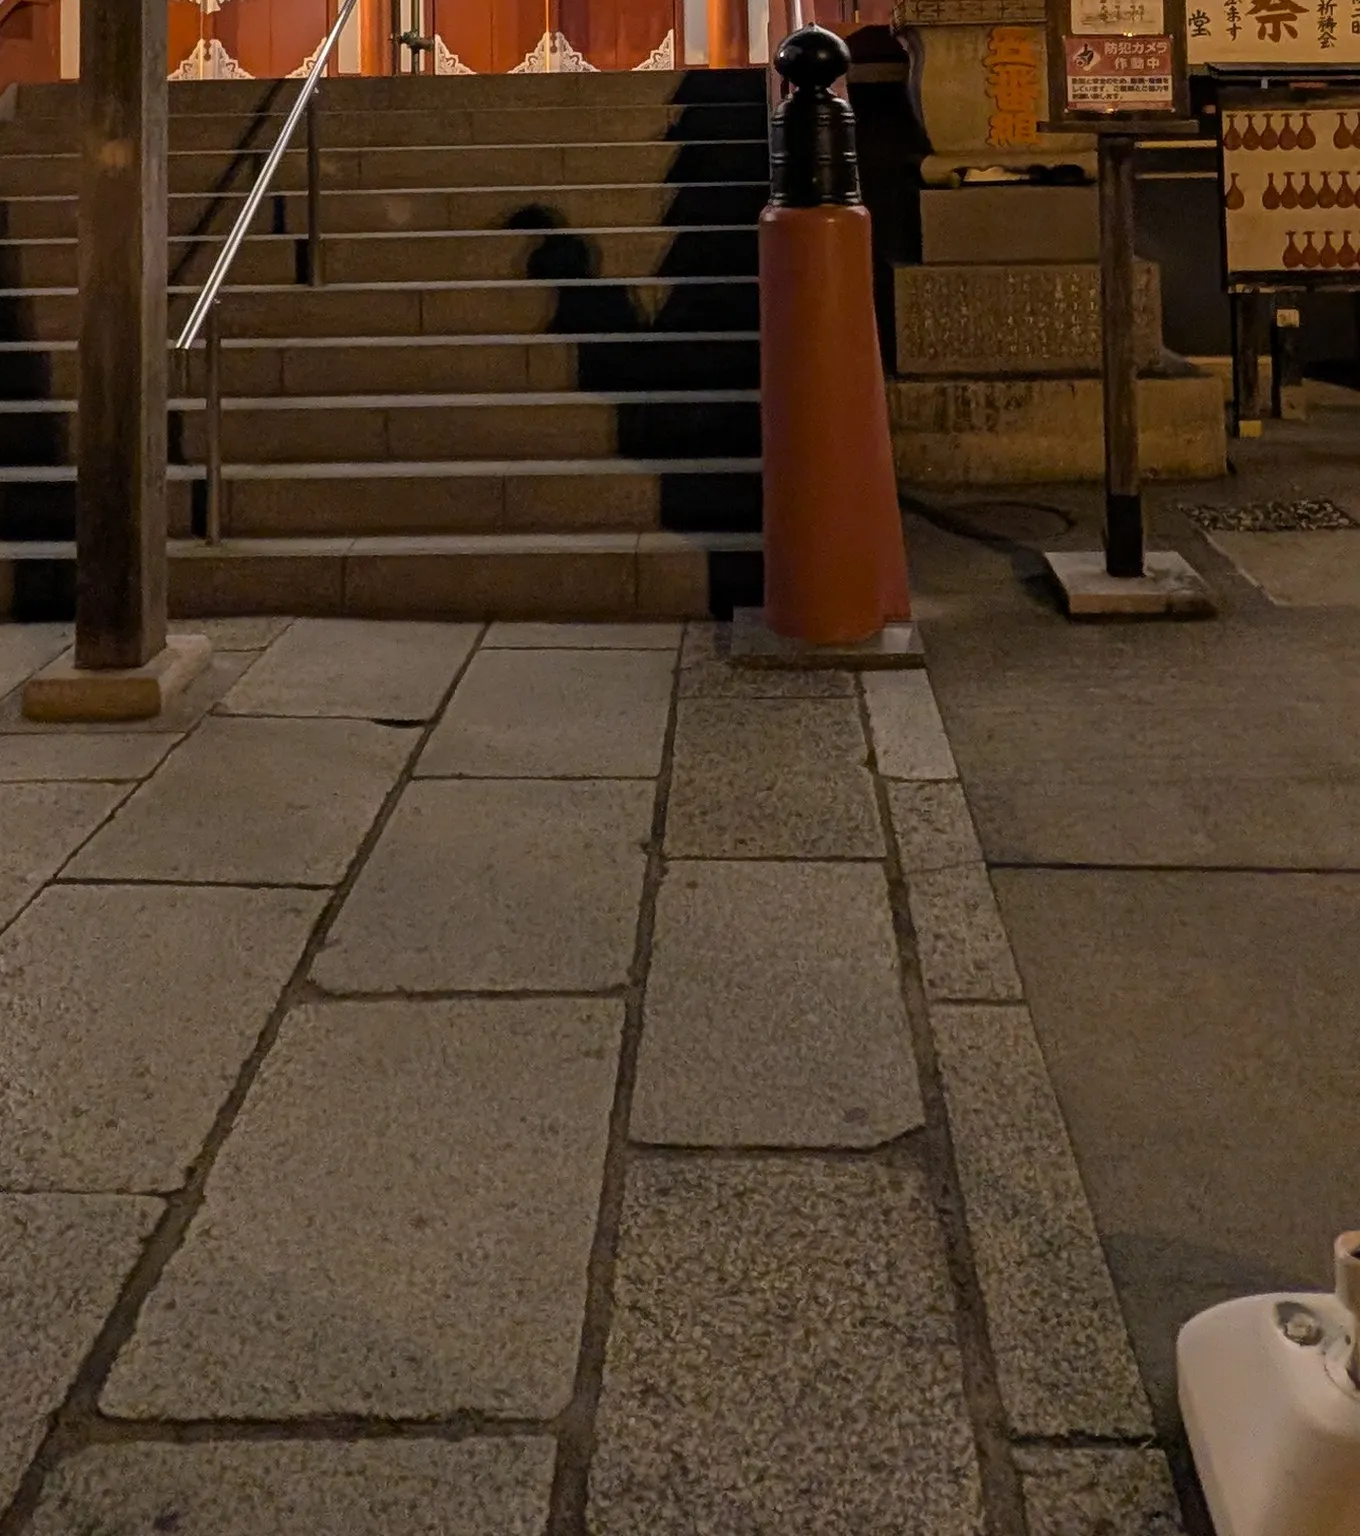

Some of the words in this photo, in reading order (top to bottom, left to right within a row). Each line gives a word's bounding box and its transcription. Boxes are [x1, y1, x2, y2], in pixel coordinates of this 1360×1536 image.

[1104, 41, 1168, 55] 防犯カメラ
